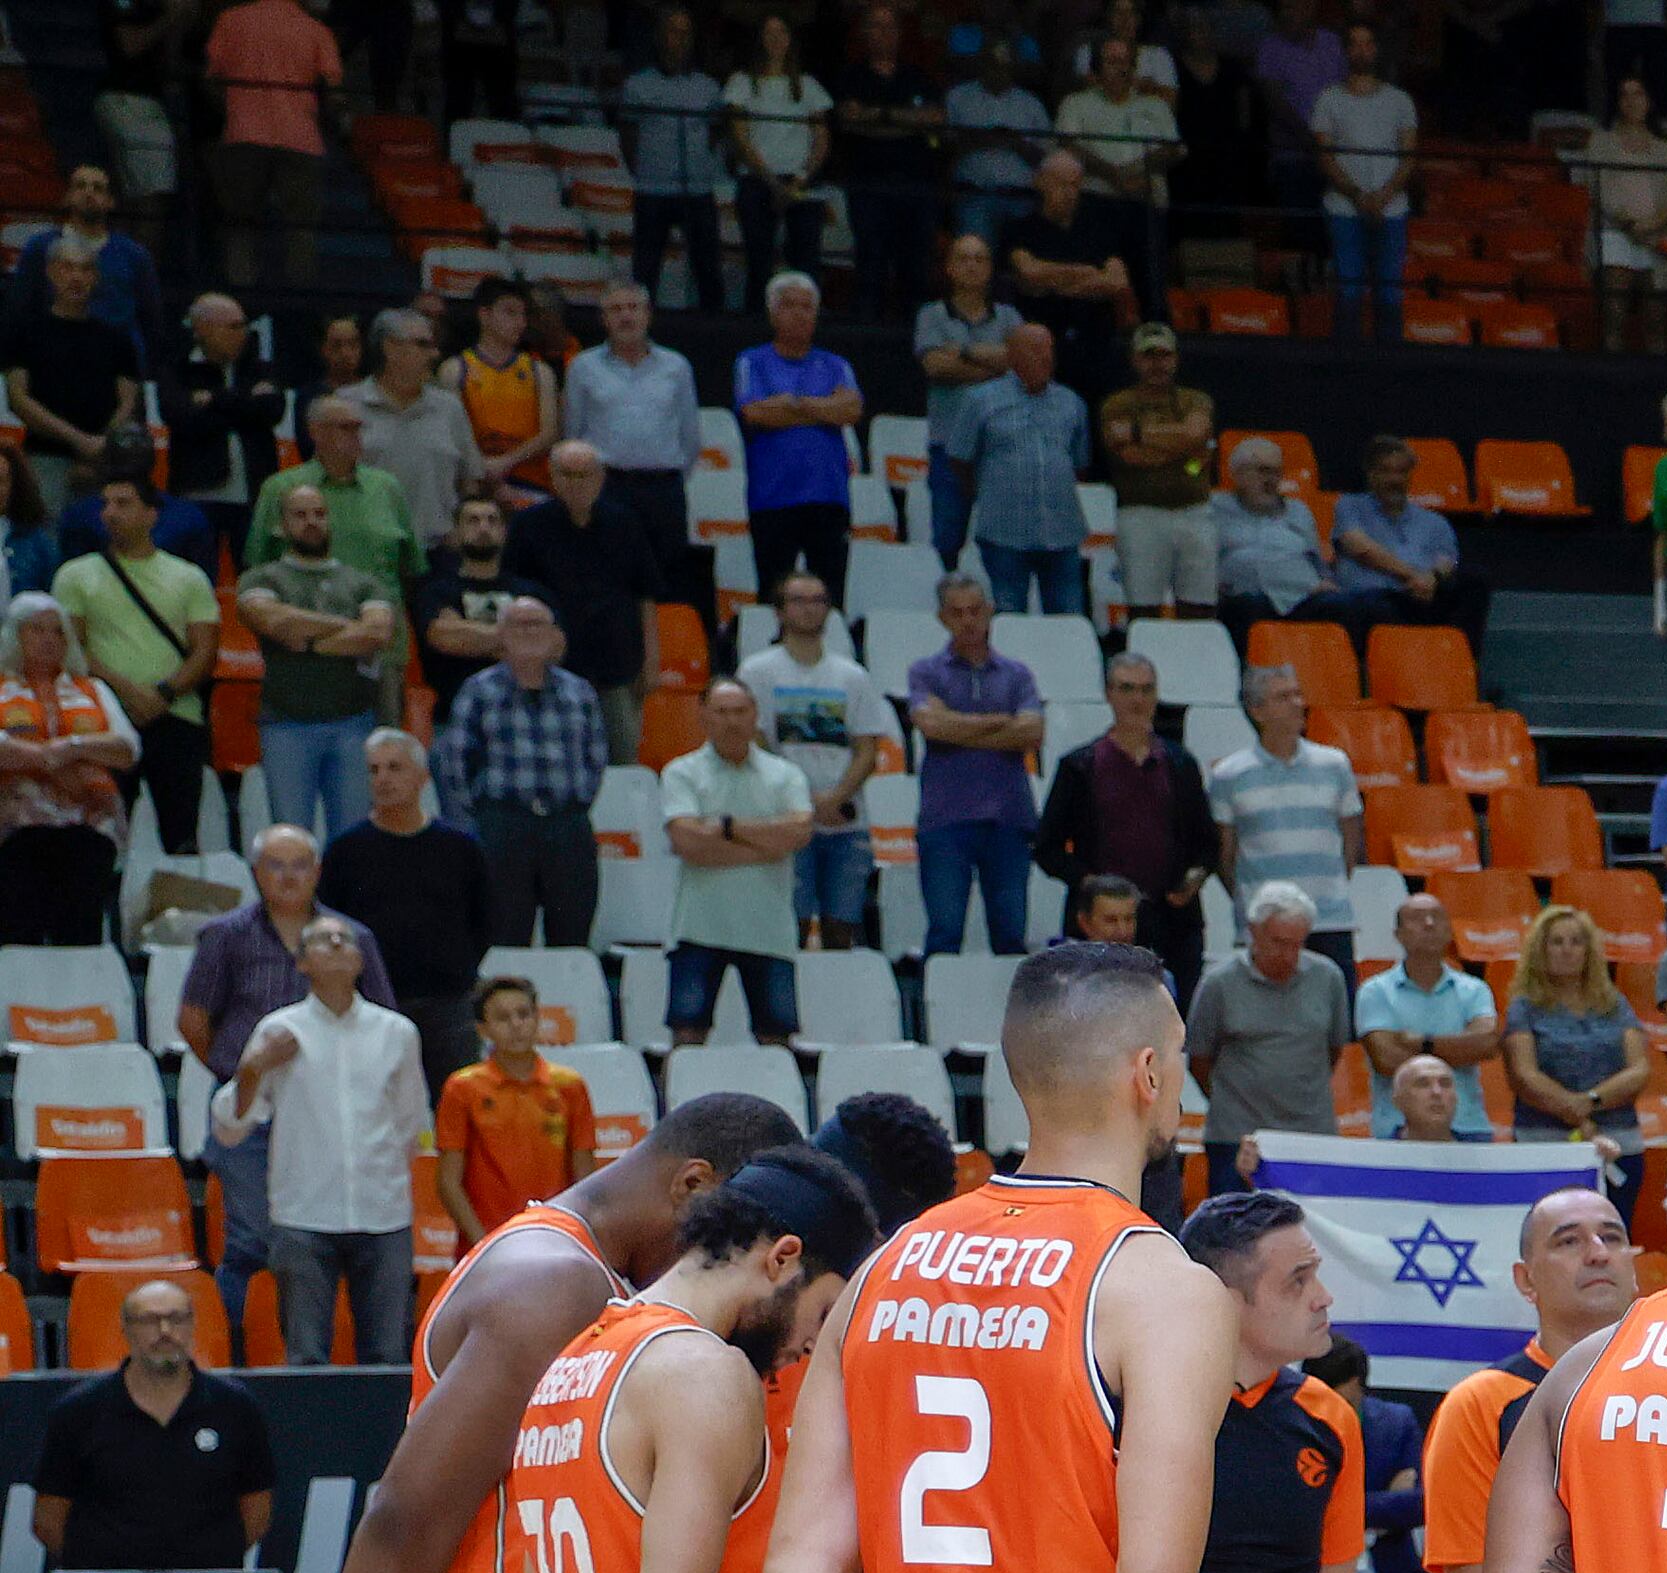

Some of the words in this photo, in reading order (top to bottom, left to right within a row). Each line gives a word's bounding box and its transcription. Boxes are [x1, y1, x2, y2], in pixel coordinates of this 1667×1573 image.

[891, 1230, 1074, 1289] PUERTO
[868, 1297, 1050, 1352] PAMESA
[901, 1374, 994, 1566] 2
